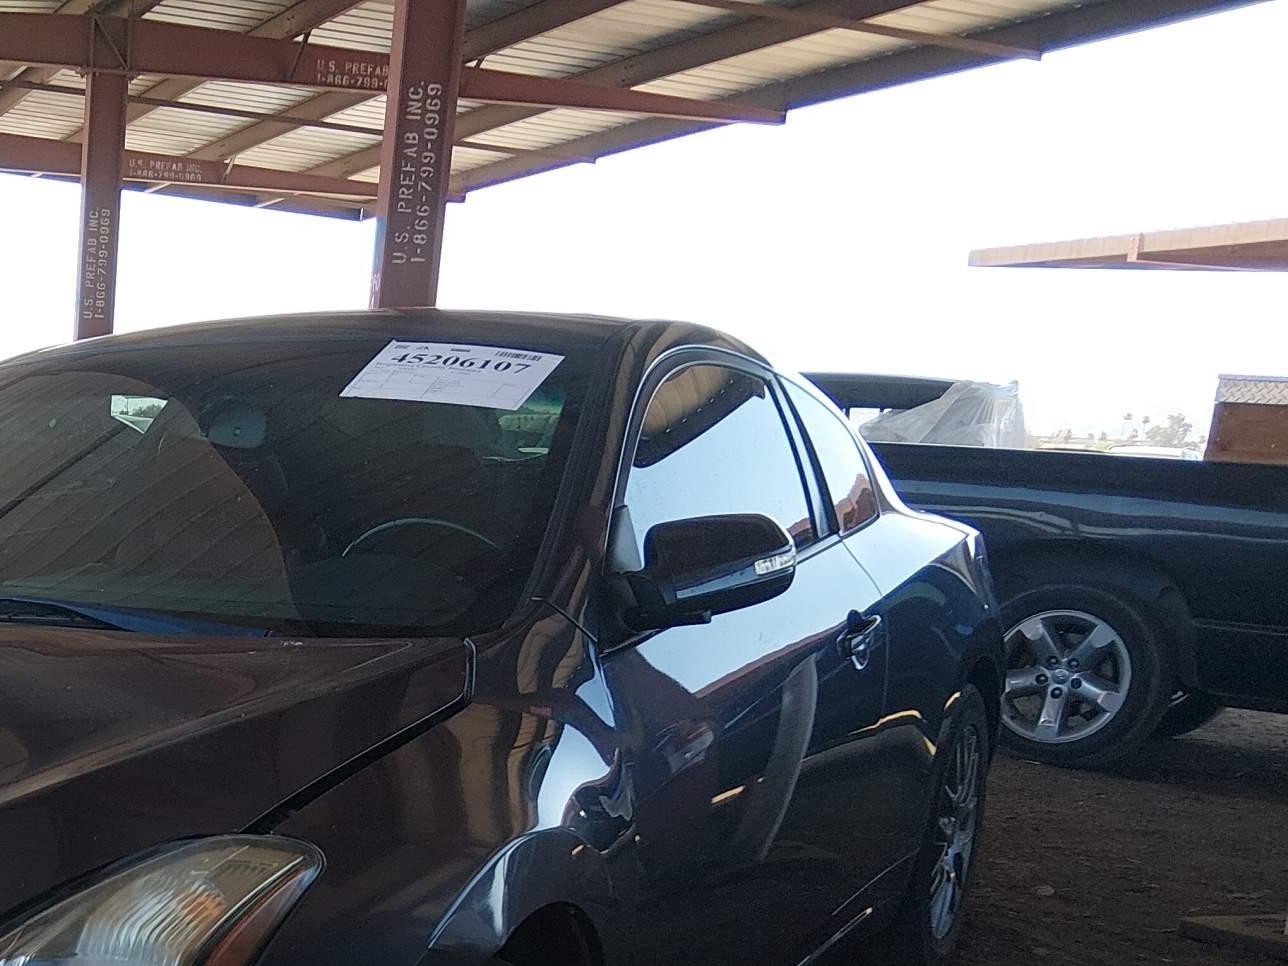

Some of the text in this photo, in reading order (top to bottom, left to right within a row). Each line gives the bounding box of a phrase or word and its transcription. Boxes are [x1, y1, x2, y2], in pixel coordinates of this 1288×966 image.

[345, 62, 389, 78] PREFAB
[392, 80, 425, 264] U.S. PREFAB INC.
[411, 83, 442, 262] 1-866-799-0969
[88, 207, 100, 231] INC.
[85, 238, 97, 288] PREFAB
[95, 208, 111, 319] 1-866-799-0969
[391, 353, 532, 374] 45206107
